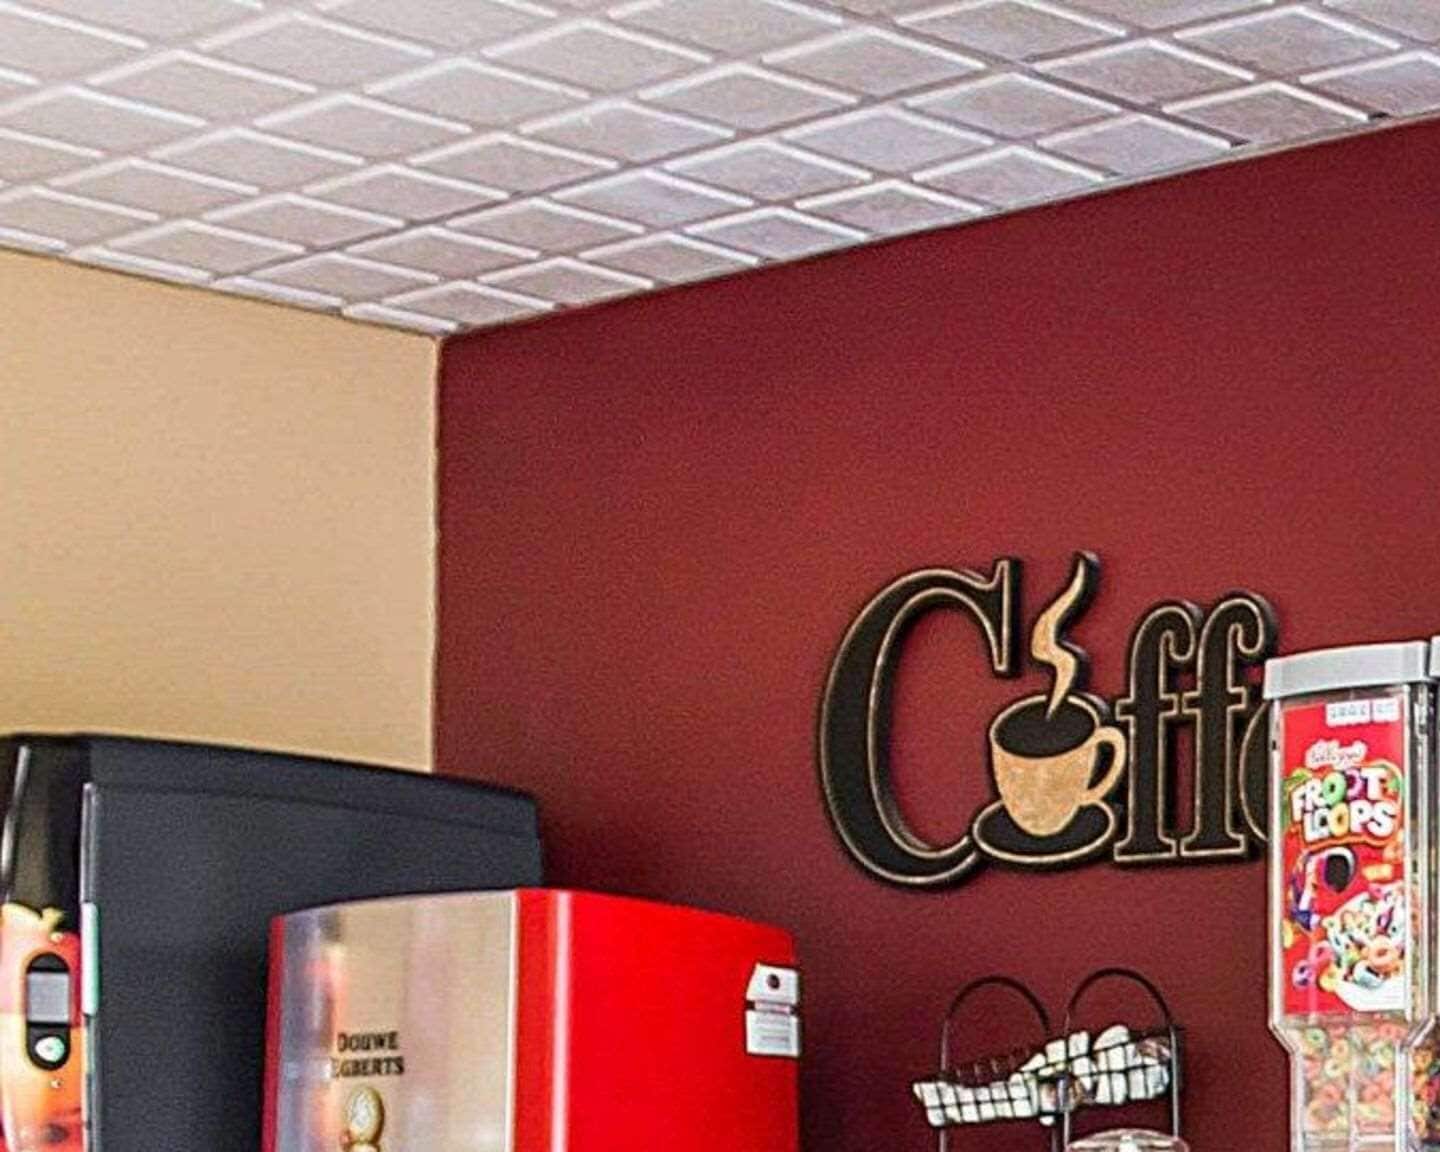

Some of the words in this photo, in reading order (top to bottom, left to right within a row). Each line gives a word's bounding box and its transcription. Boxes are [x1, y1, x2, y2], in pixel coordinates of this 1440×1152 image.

[1291, 767, 1387, 822] FROOT
[1303, 800, 1397, 842] LOOPS
[337, 1032, 399, 1052] DOUWE
[330, 1056, 405, 1078] EGBERTS
